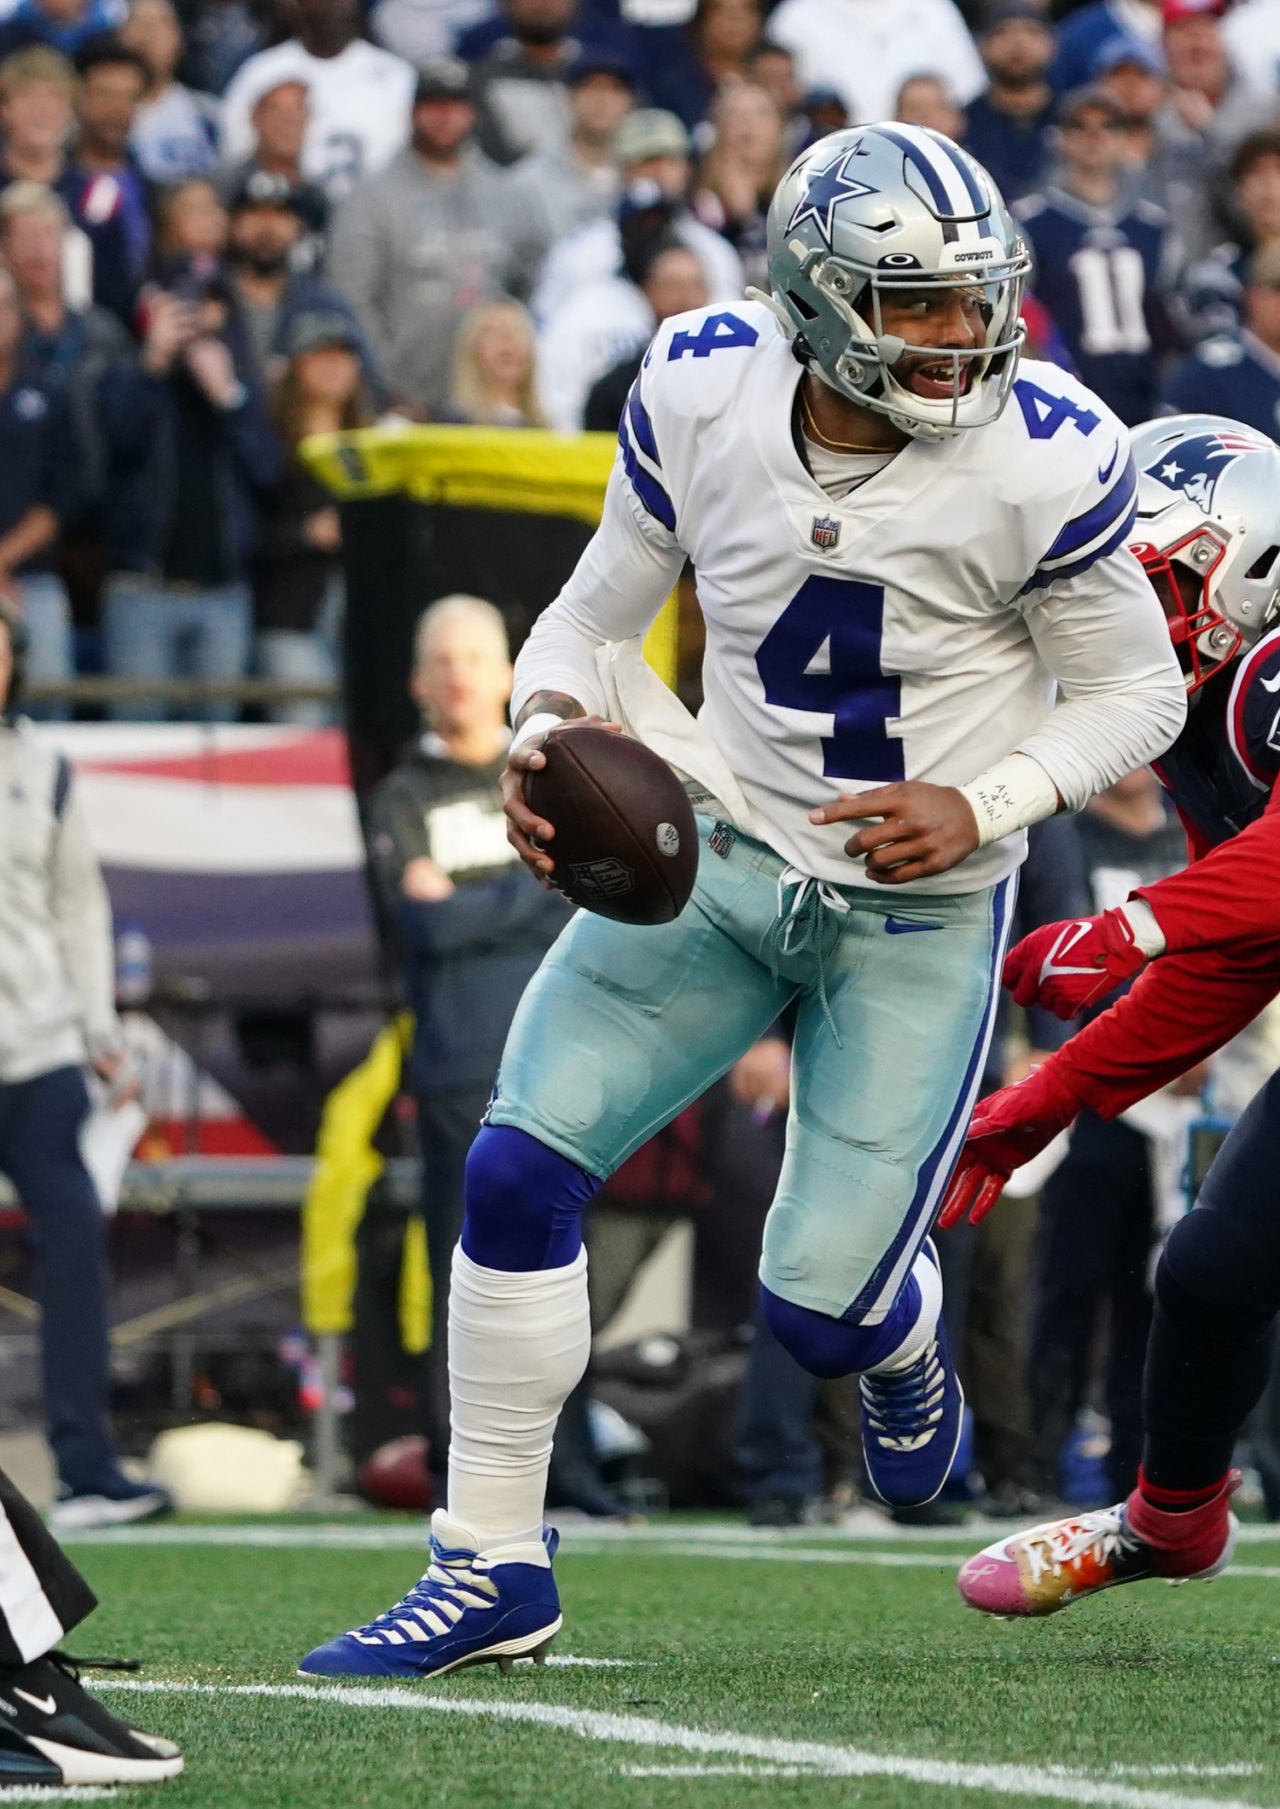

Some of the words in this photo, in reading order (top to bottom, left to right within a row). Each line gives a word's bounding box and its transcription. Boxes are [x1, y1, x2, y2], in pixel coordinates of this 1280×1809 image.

[667, 311, 760, 362] 4
[1069, 246, 1151, 354] 11
[1011, 377, 1103, 440] 4
[754, 573, 906, 782] 4
